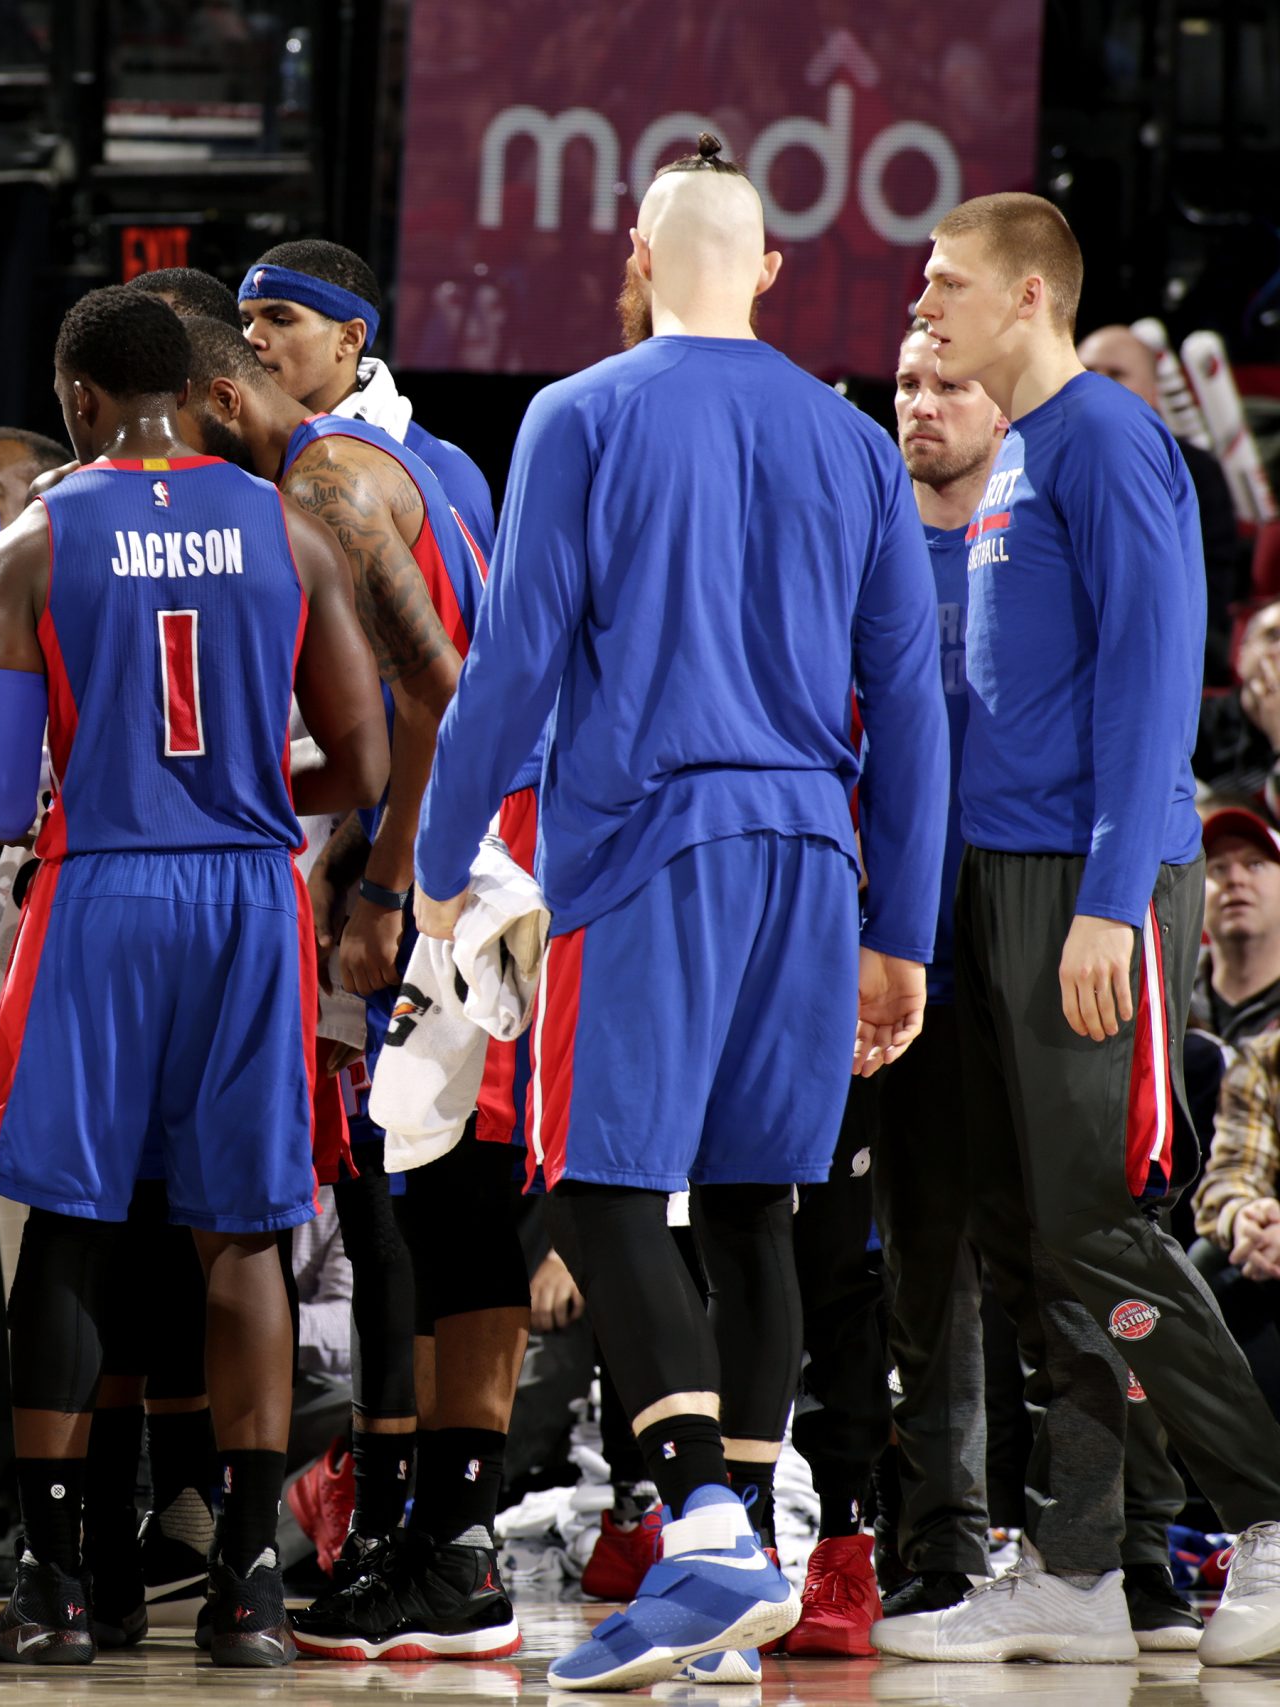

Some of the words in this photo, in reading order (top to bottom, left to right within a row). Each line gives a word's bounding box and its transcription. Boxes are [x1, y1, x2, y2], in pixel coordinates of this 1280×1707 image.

[111, 528, 244, 578] JACKSON
[157, 609, 206, 757] 1
[1107, 1306, 1161, 1338] PISTONS
